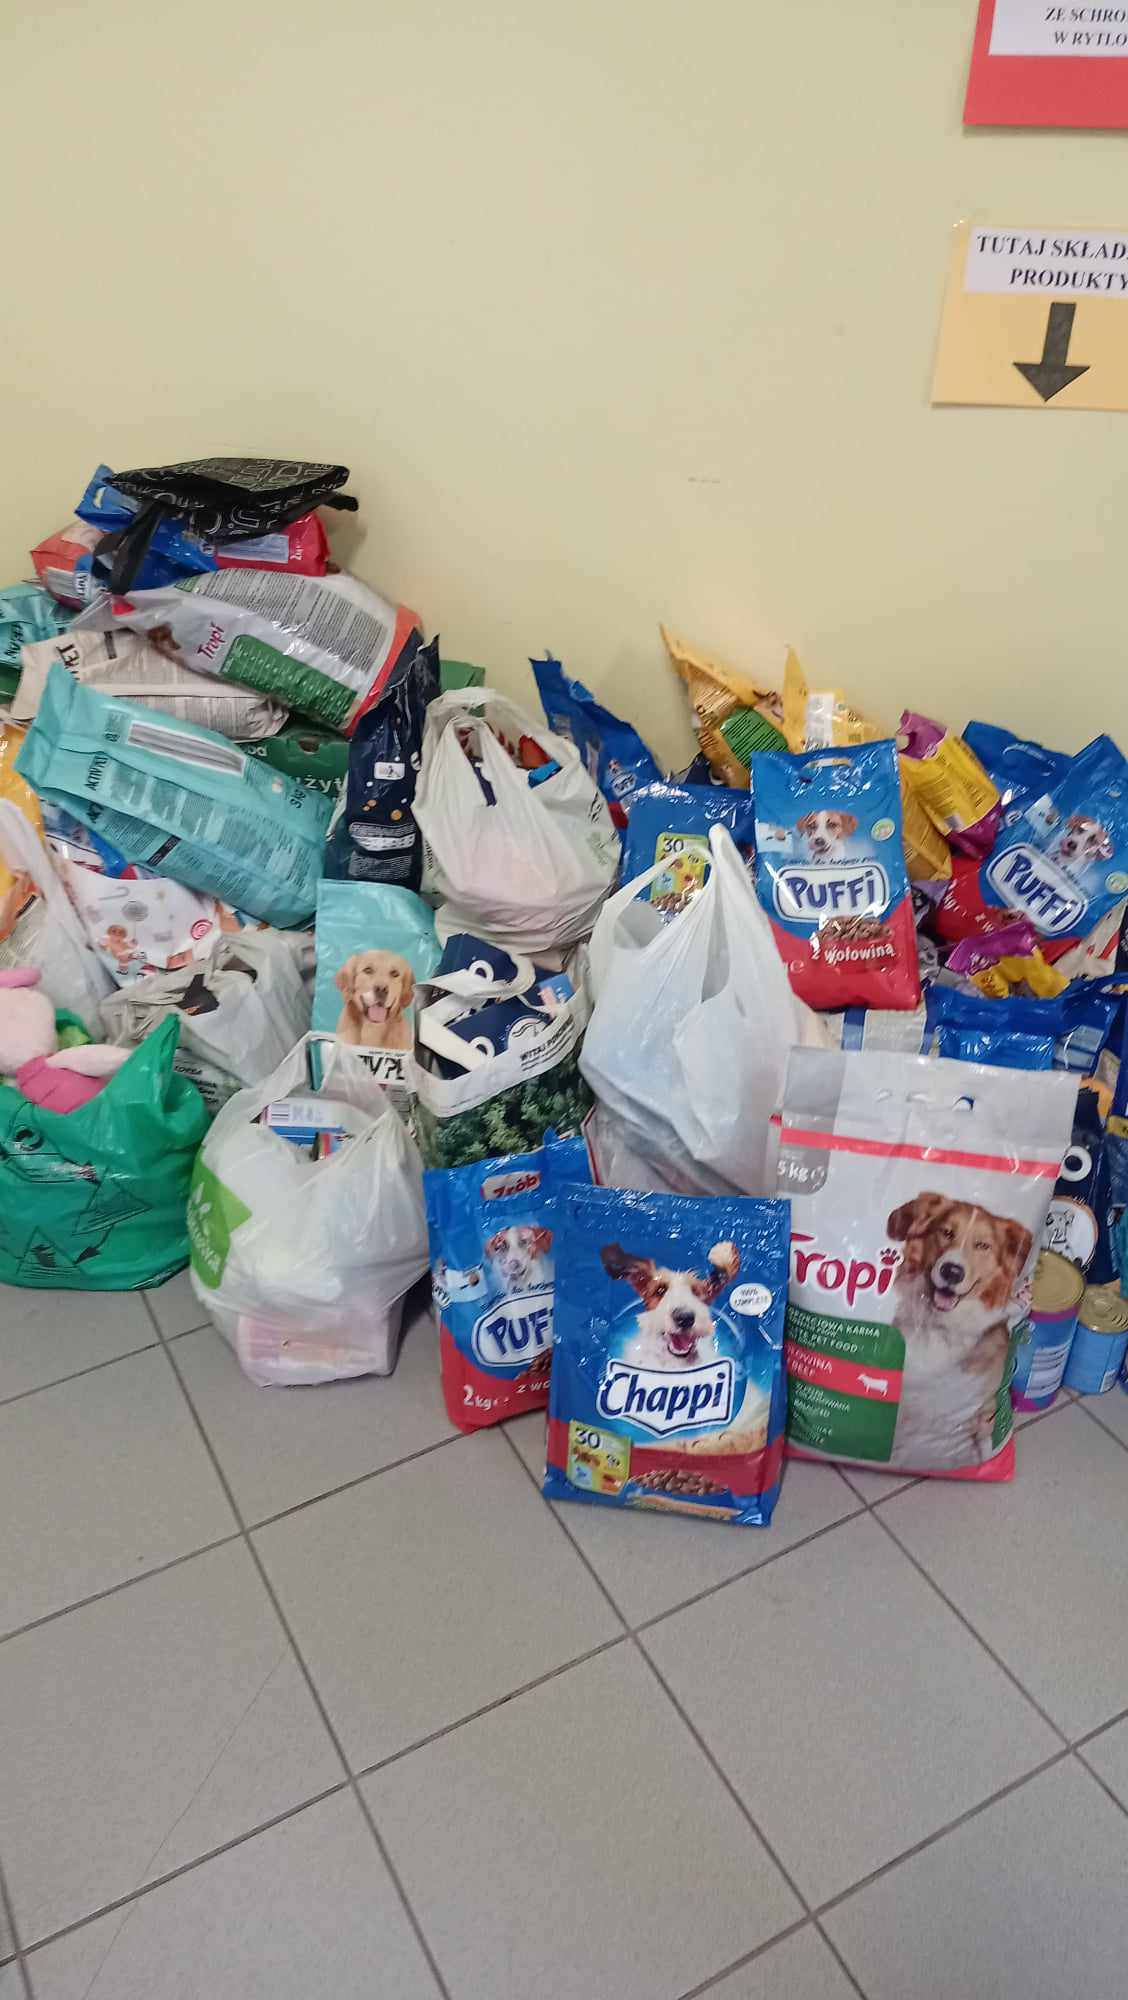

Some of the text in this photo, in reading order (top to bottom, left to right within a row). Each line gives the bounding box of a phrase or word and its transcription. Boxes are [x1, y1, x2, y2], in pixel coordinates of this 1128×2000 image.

[1045, 7, 1066, 21] ZE
[1055, 32, 1069, 44] W
[977, 235, 1128, 260] TUTAJ SKŁAD
[197, 621, 225, 660] Tropi
[663, 837, 684, 852] 30
[486, 1307, 555, 1356] PUF
[846, 1324, 881, 1338] KARMA
[600, 1372, 726, 1421] Chappi
[575, 1427, 600, 1449] 30
